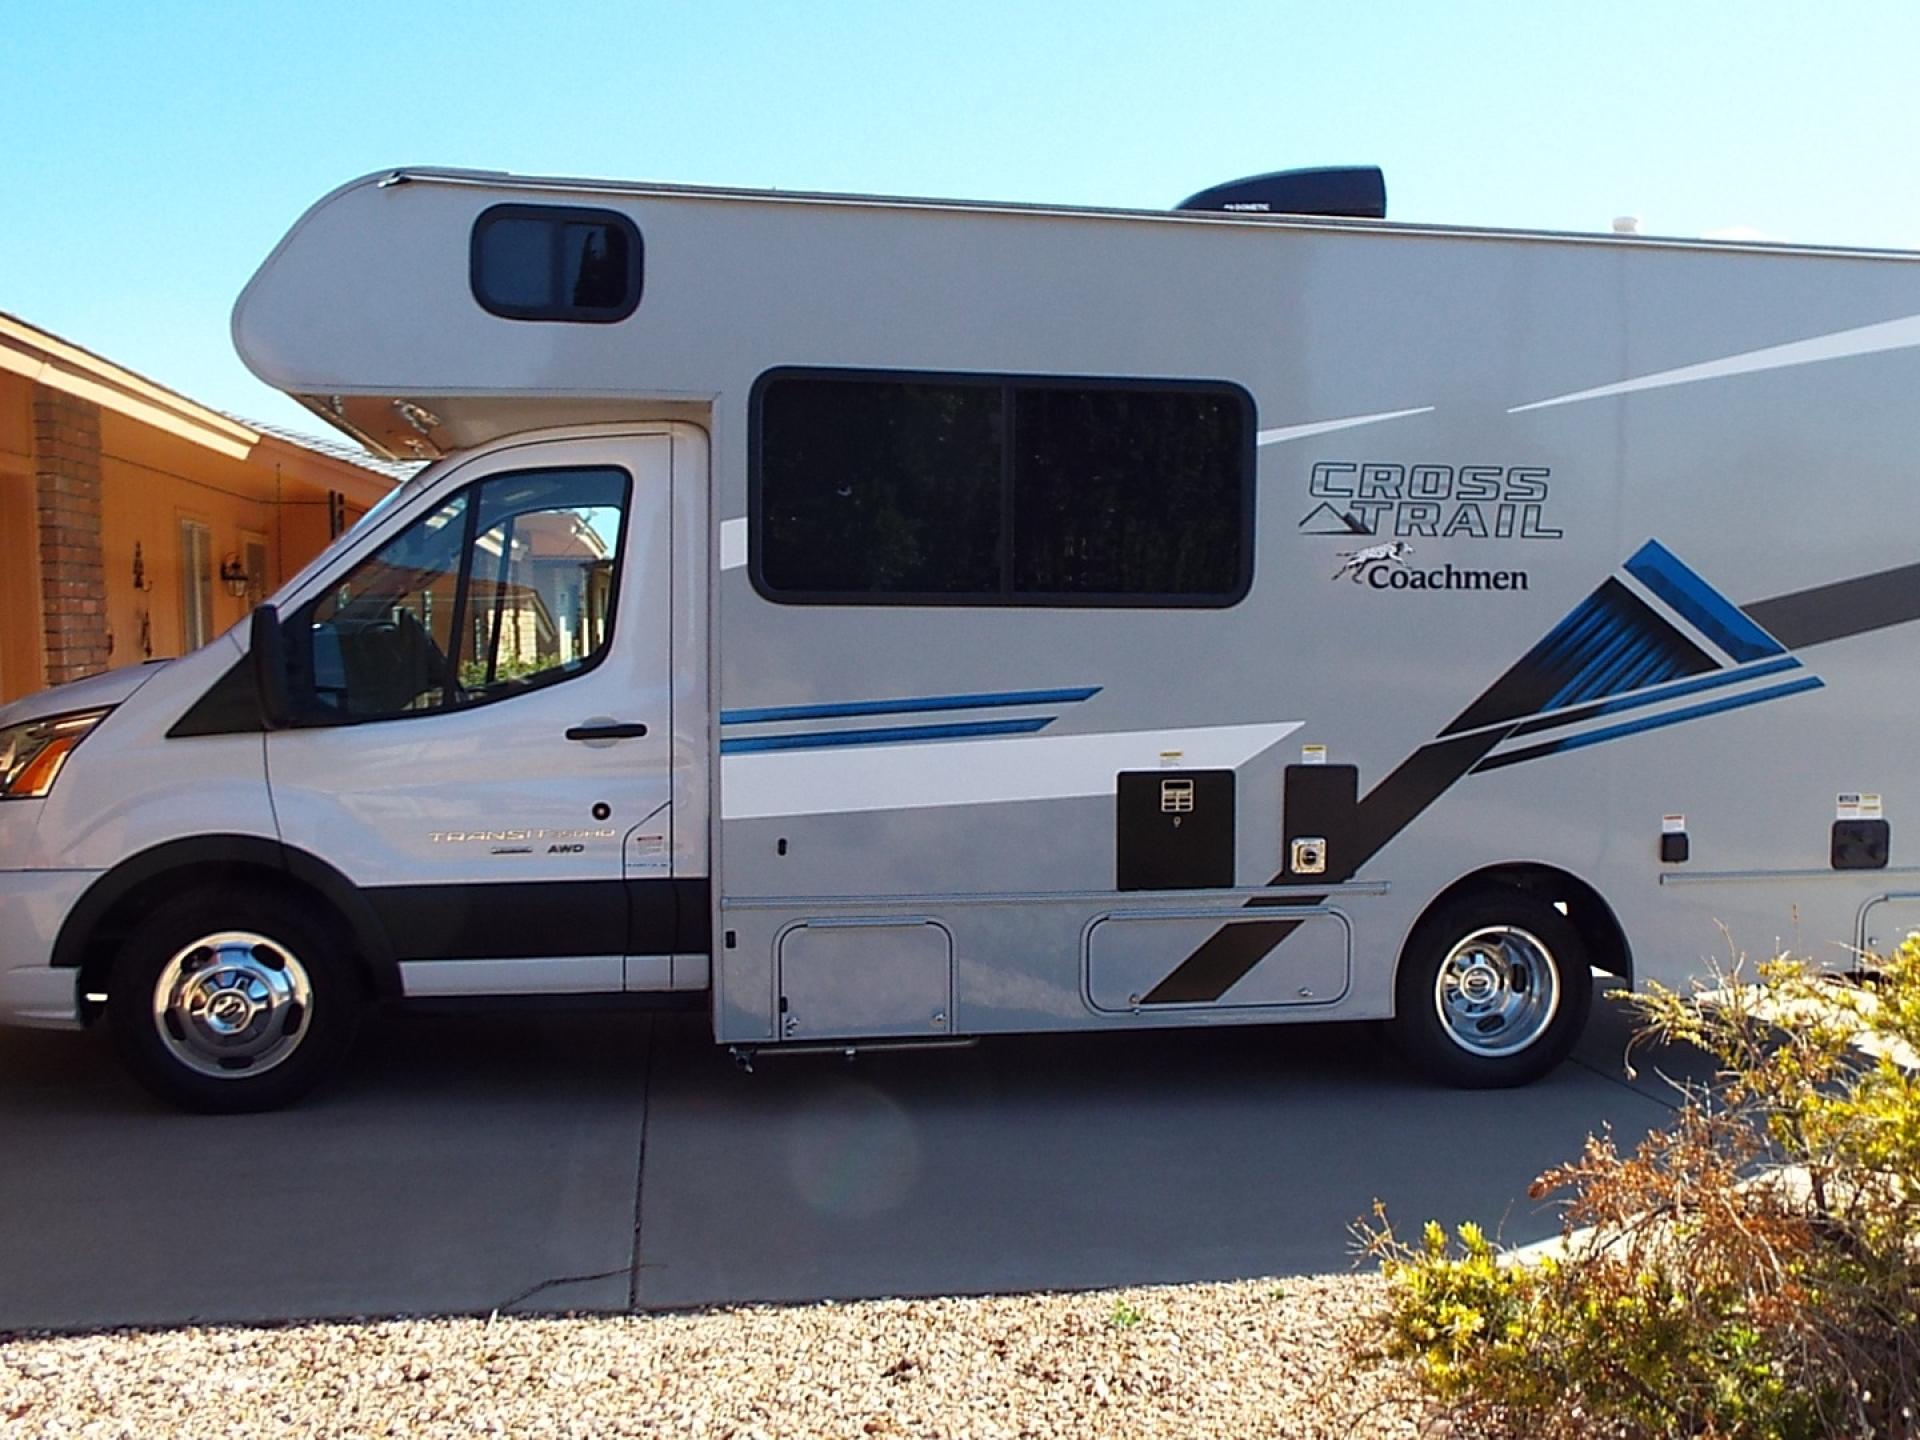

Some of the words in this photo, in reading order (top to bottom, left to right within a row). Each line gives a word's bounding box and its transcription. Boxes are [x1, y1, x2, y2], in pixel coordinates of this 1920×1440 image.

[1309, 461, 1551, 502] CROSS
[1349, 500, 1564, 539] TRAIL
[1367, 563, 1529, 591] Coachmen
[429, 829, 549, 843] TRANSIT
[547, 843, 585, 854] AWD
